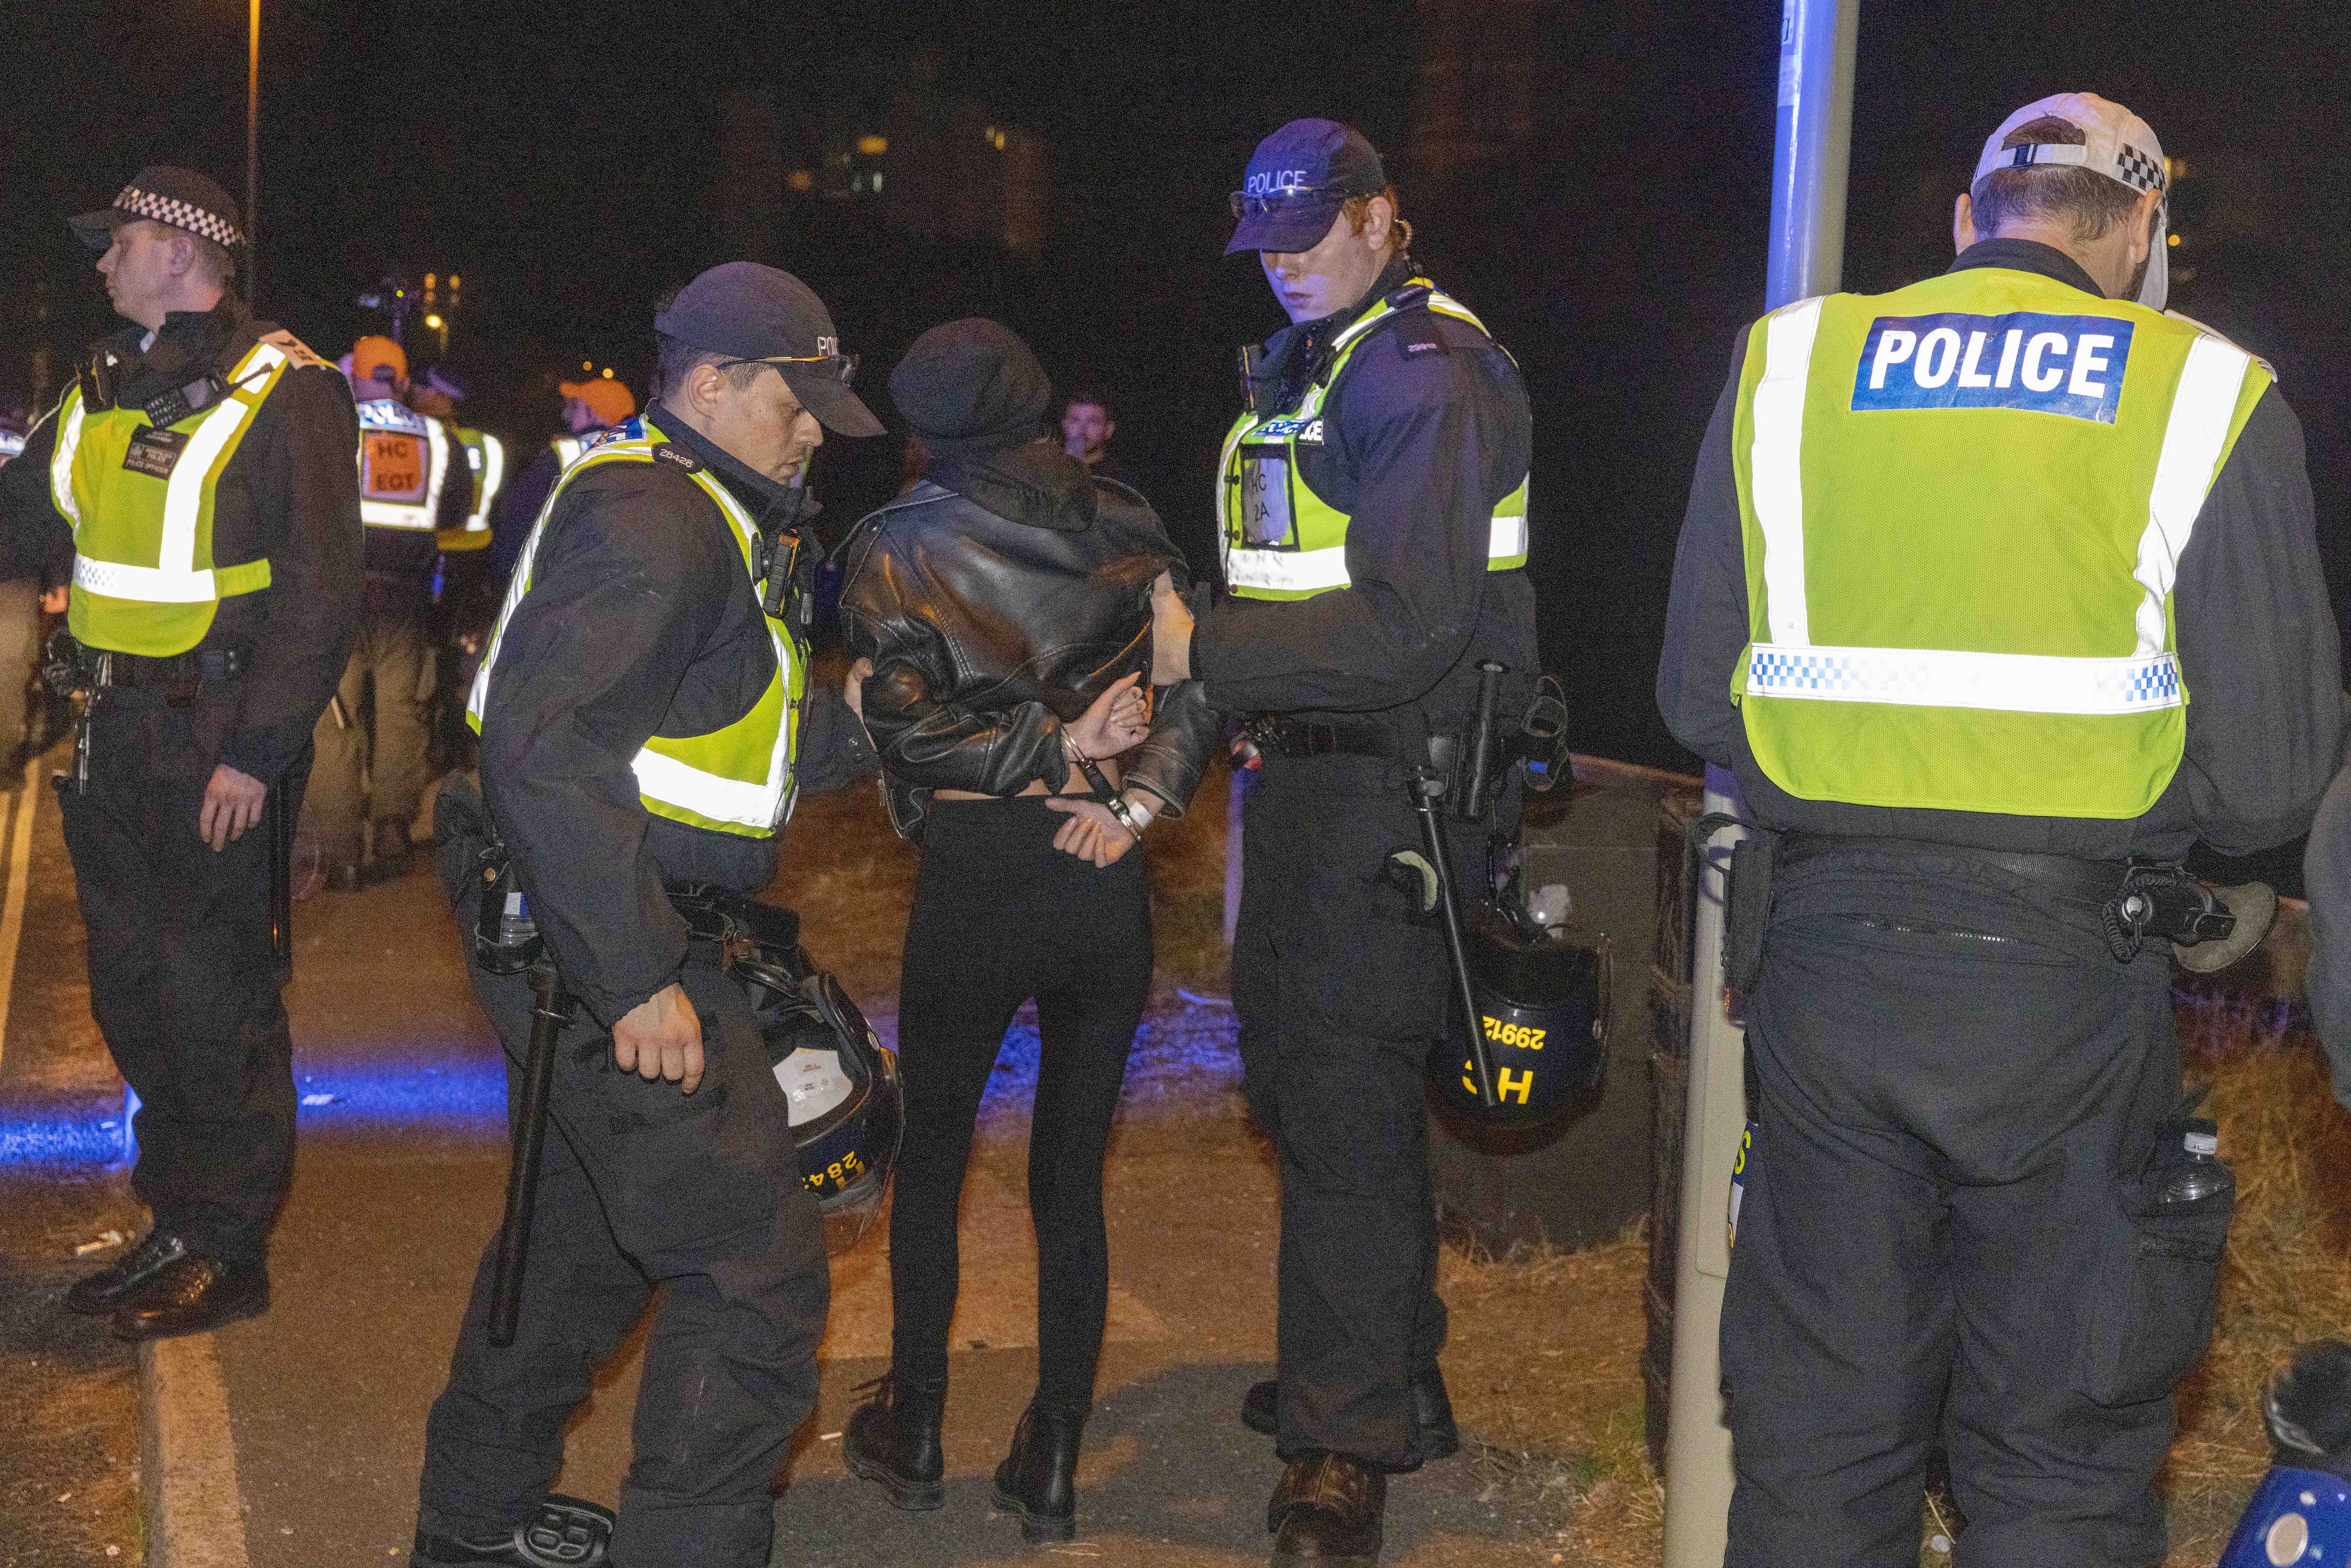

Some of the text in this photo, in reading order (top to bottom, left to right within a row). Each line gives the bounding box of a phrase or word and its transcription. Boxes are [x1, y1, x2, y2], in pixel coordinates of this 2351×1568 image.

[1248, 171, 1307, 193] POLICE
[1869, 327, 2115, 399] POLICE
[659, 448, 694, 468] 28428
[1254, 501, 1270, 522] 2A
[1482, 1015, 1546, 1050] 29912
[802, 1150, 858, 1190] 284
